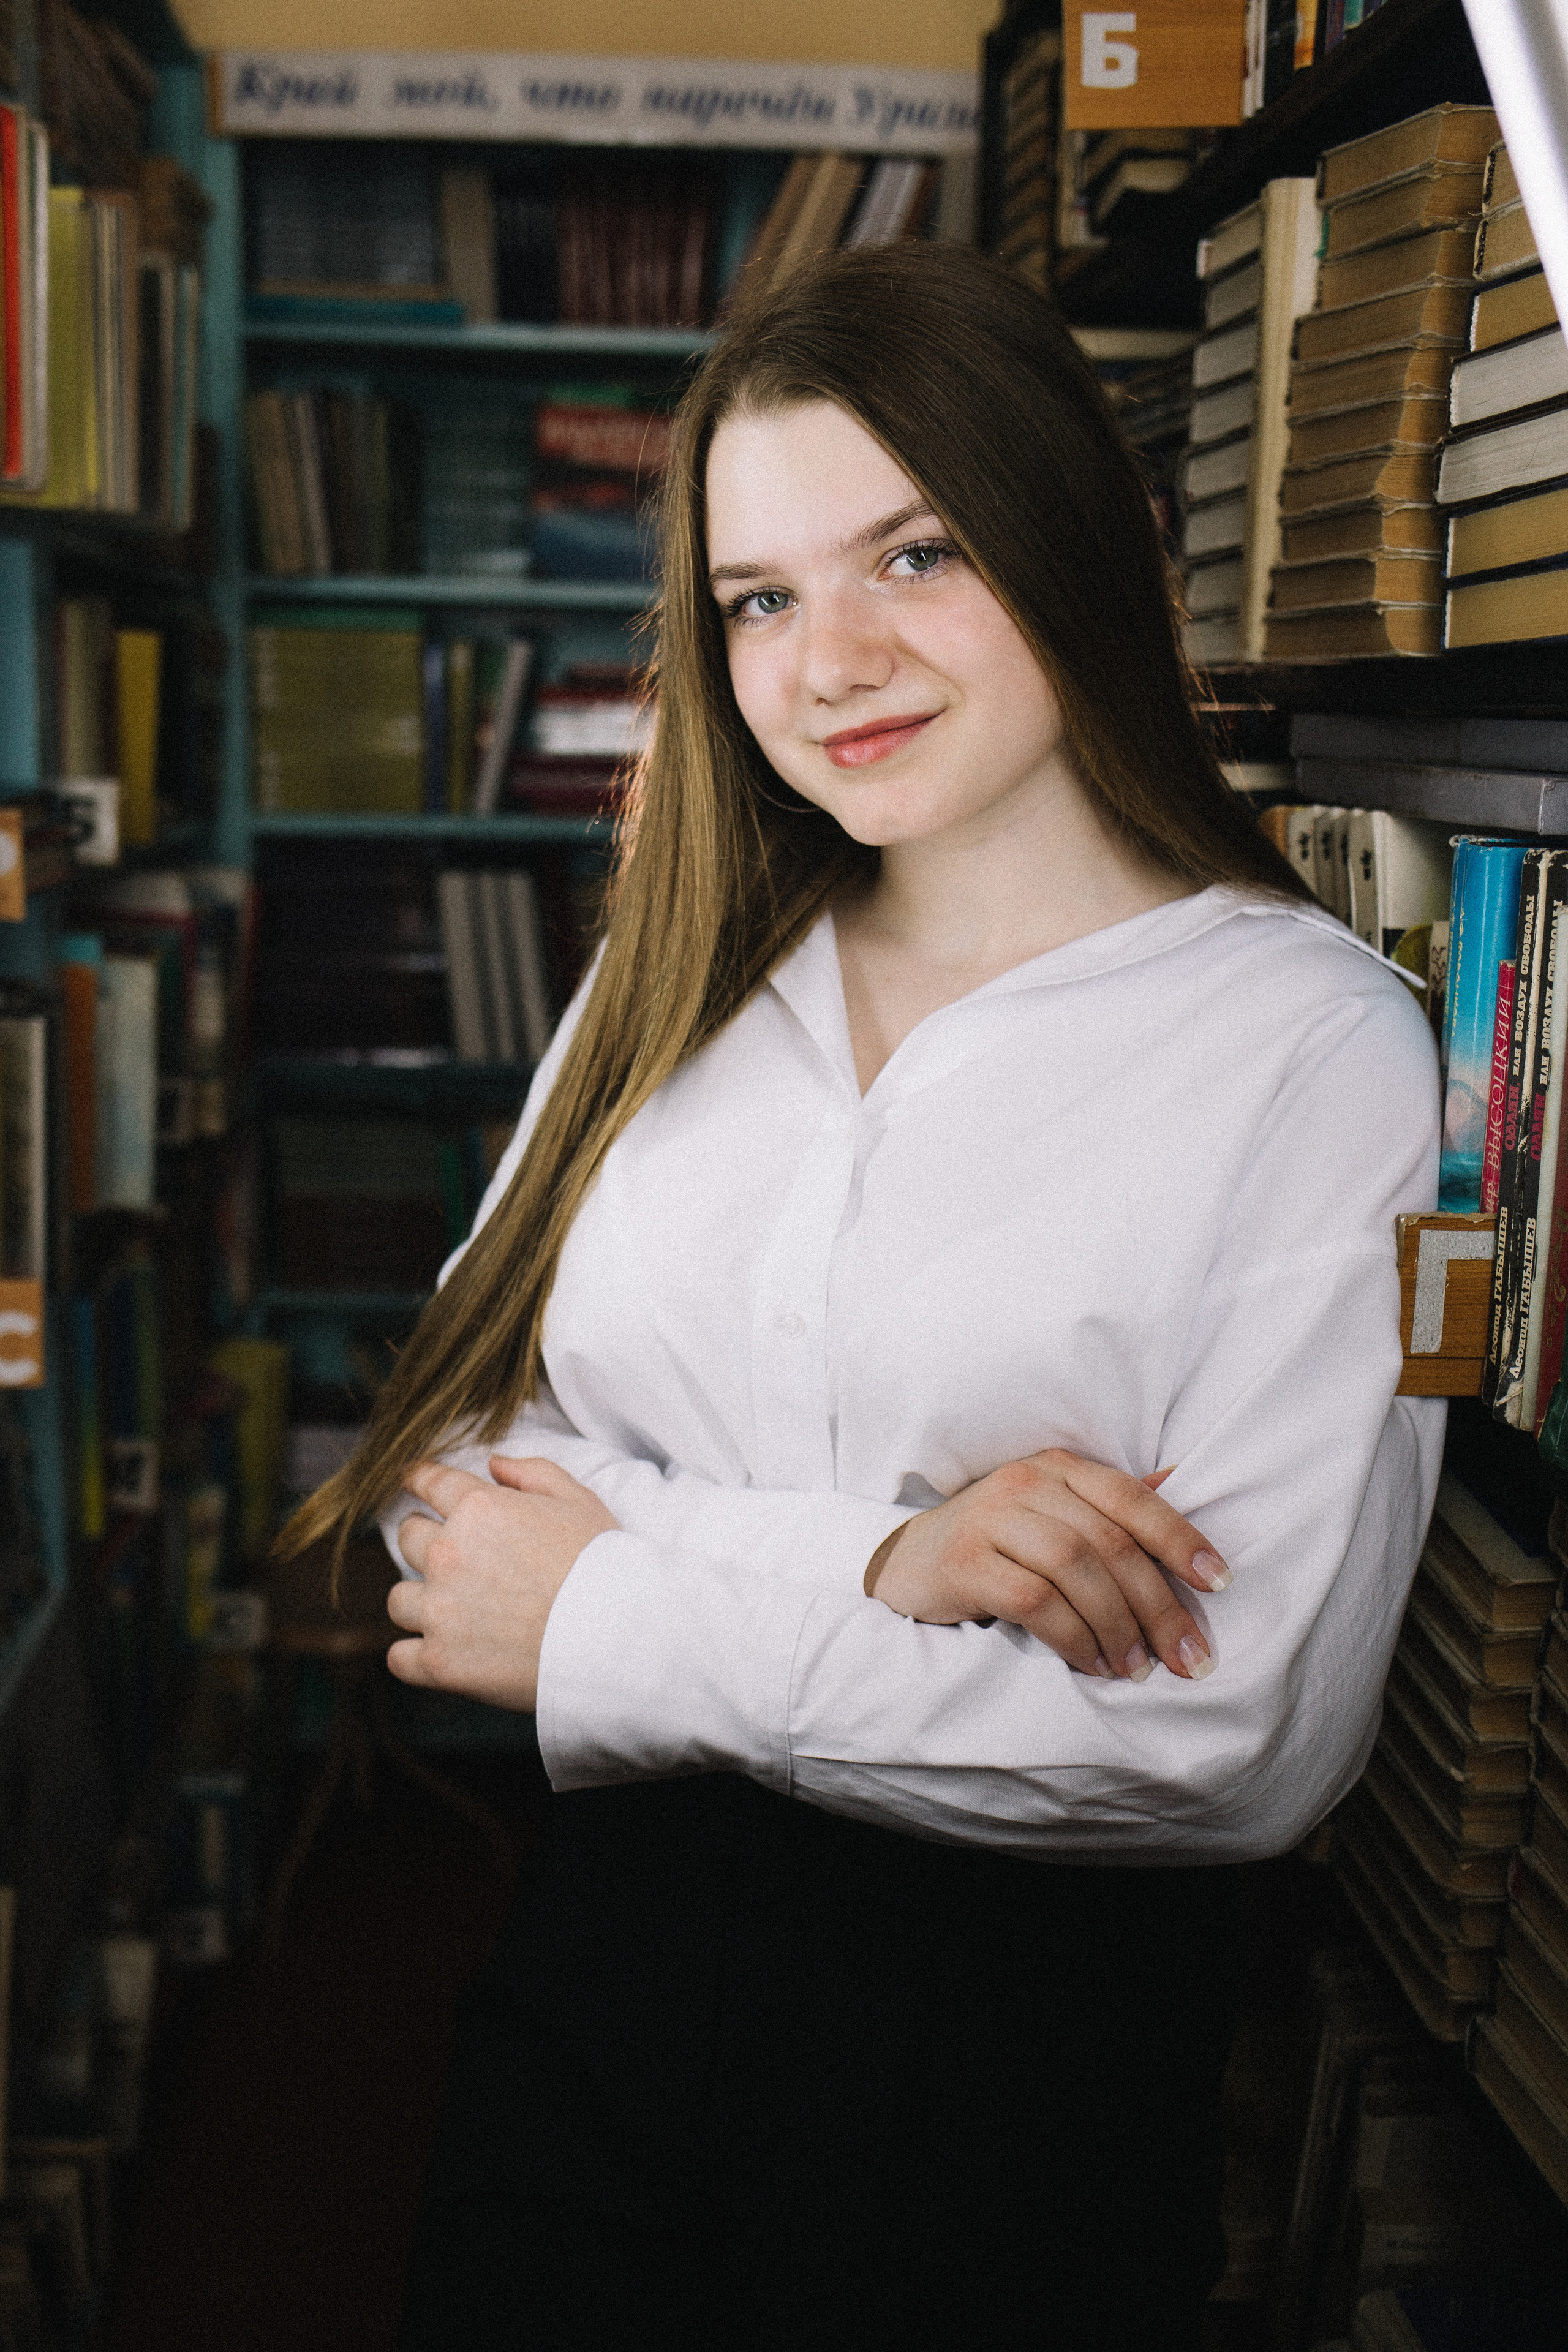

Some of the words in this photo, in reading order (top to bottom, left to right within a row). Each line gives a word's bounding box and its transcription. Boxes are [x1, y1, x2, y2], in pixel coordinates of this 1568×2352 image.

[1080, 12, 1139, 89] Б
[1520, 894, 1536, 976] СВОБОДЫ
[1514, 980, 1529, 1042] ВОЗДУХ
[1487, 995, 1512, 1171] ВЫСОЦКИЙ
[1409, 1229, 1497, 1354] Г
[1494, 1205, 1509, 1303] ГАБЫШЕВ
[1509, 1314, 1529, 1379] Леонид
[1520, 1216, 1537, 1314] ГАБЫШЕВ
[1490, 1305, 1503, 1366] Леонид
